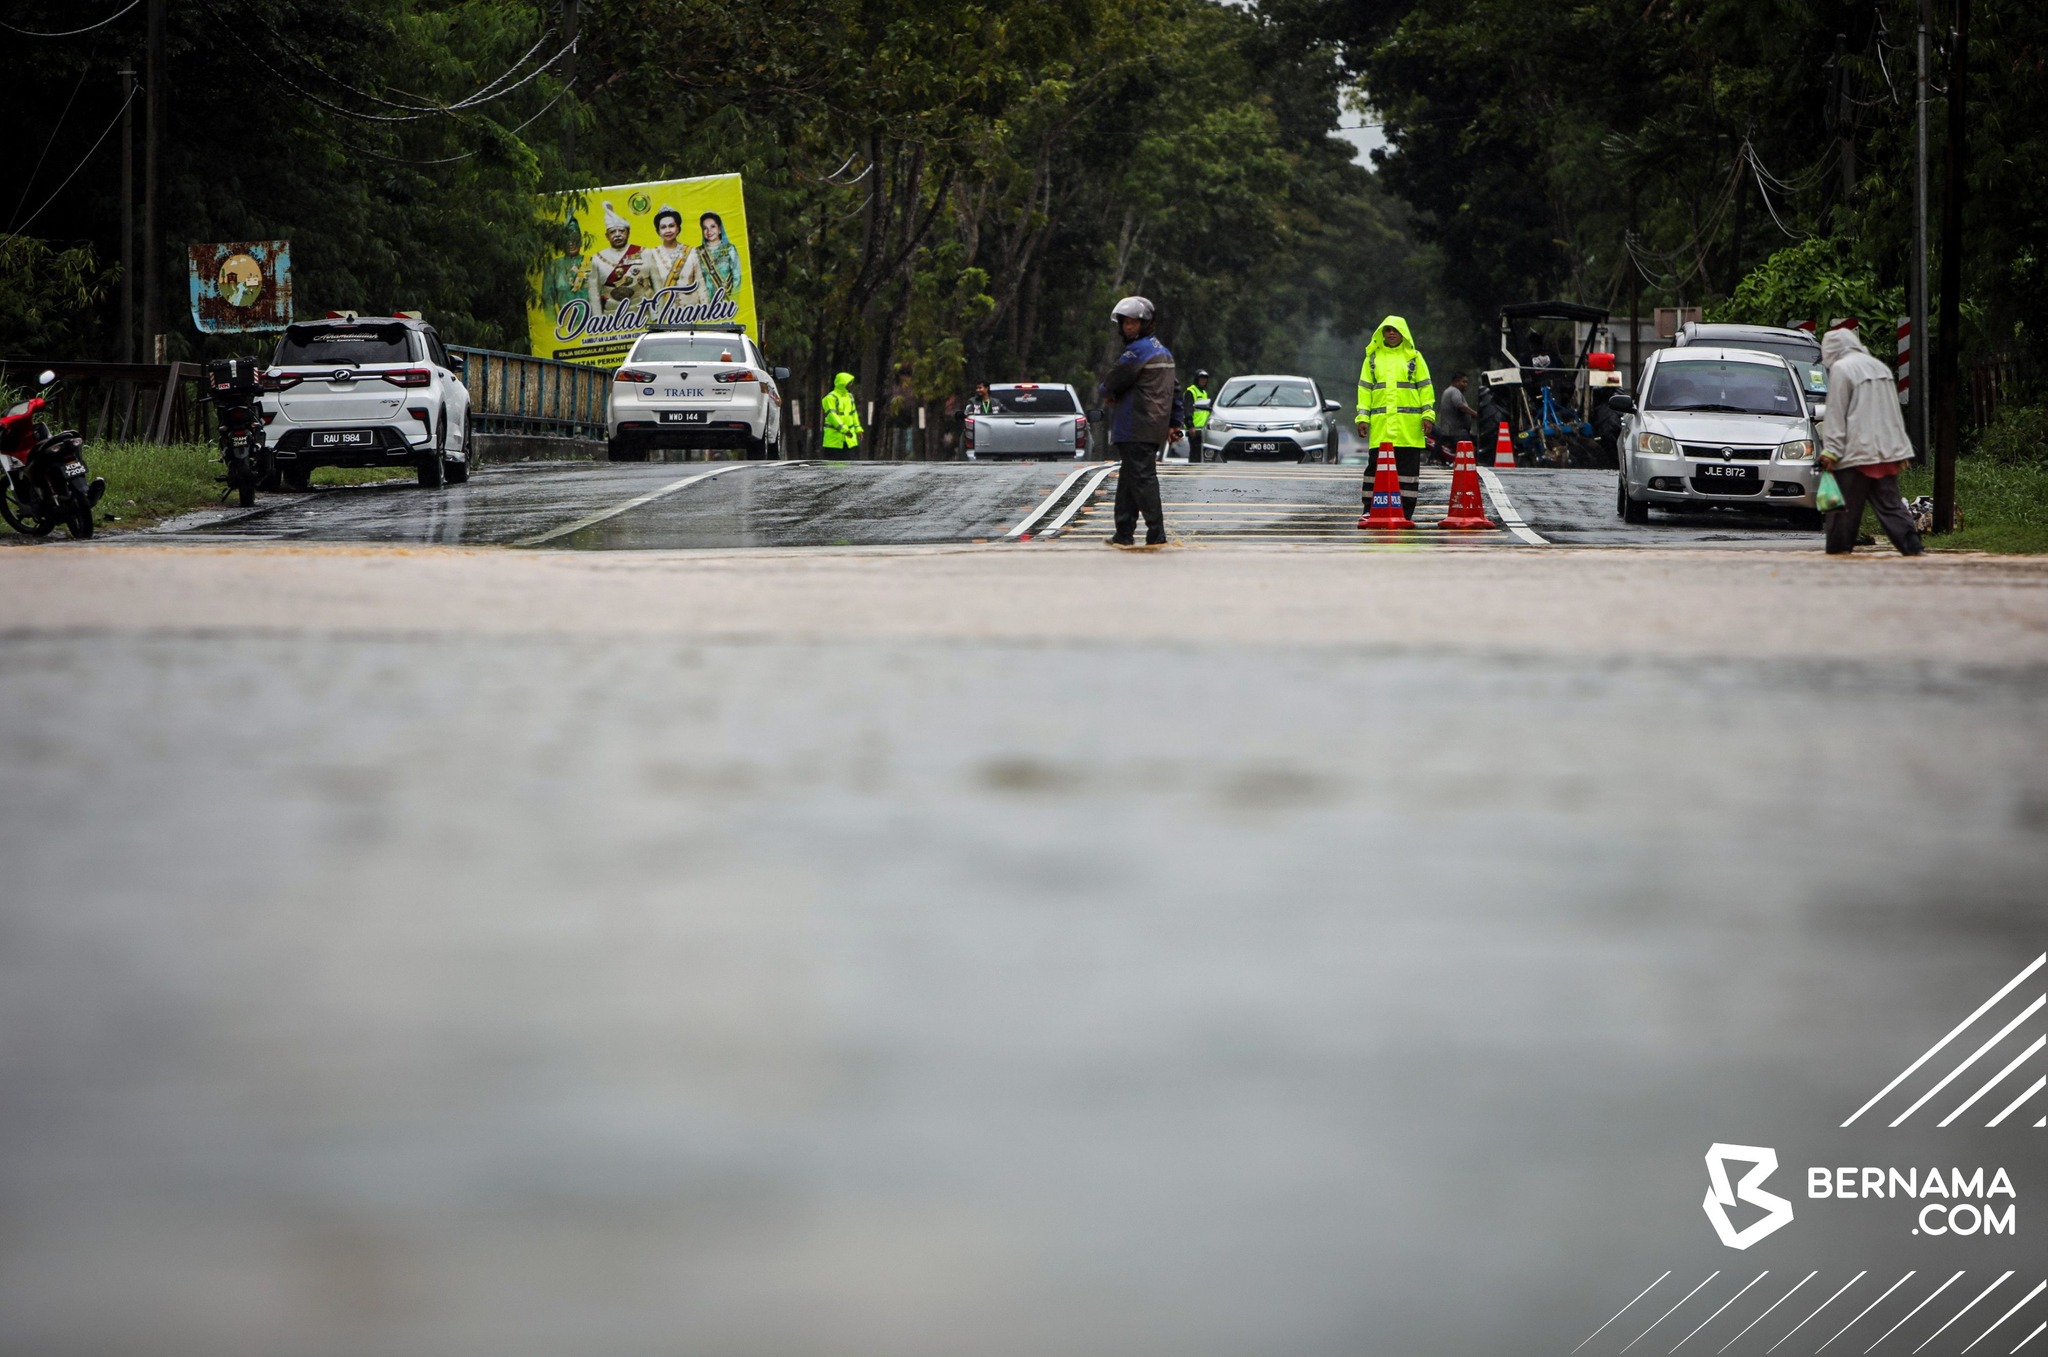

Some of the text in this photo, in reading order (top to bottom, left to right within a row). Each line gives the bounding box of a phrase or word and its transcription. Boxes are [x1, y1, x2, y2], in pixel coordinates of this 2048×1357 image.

[555, 281, 737, 342] Daulat Tuanku
[664, 388, 704, 397] TRAFIK
[669, 413, 698, 421] WWD 144
[323, 433, 360, 443] RAU 1984
[1705, 467, 1746, 477] JLE 8172
[1373, 495, 1388, 505] POLIS
